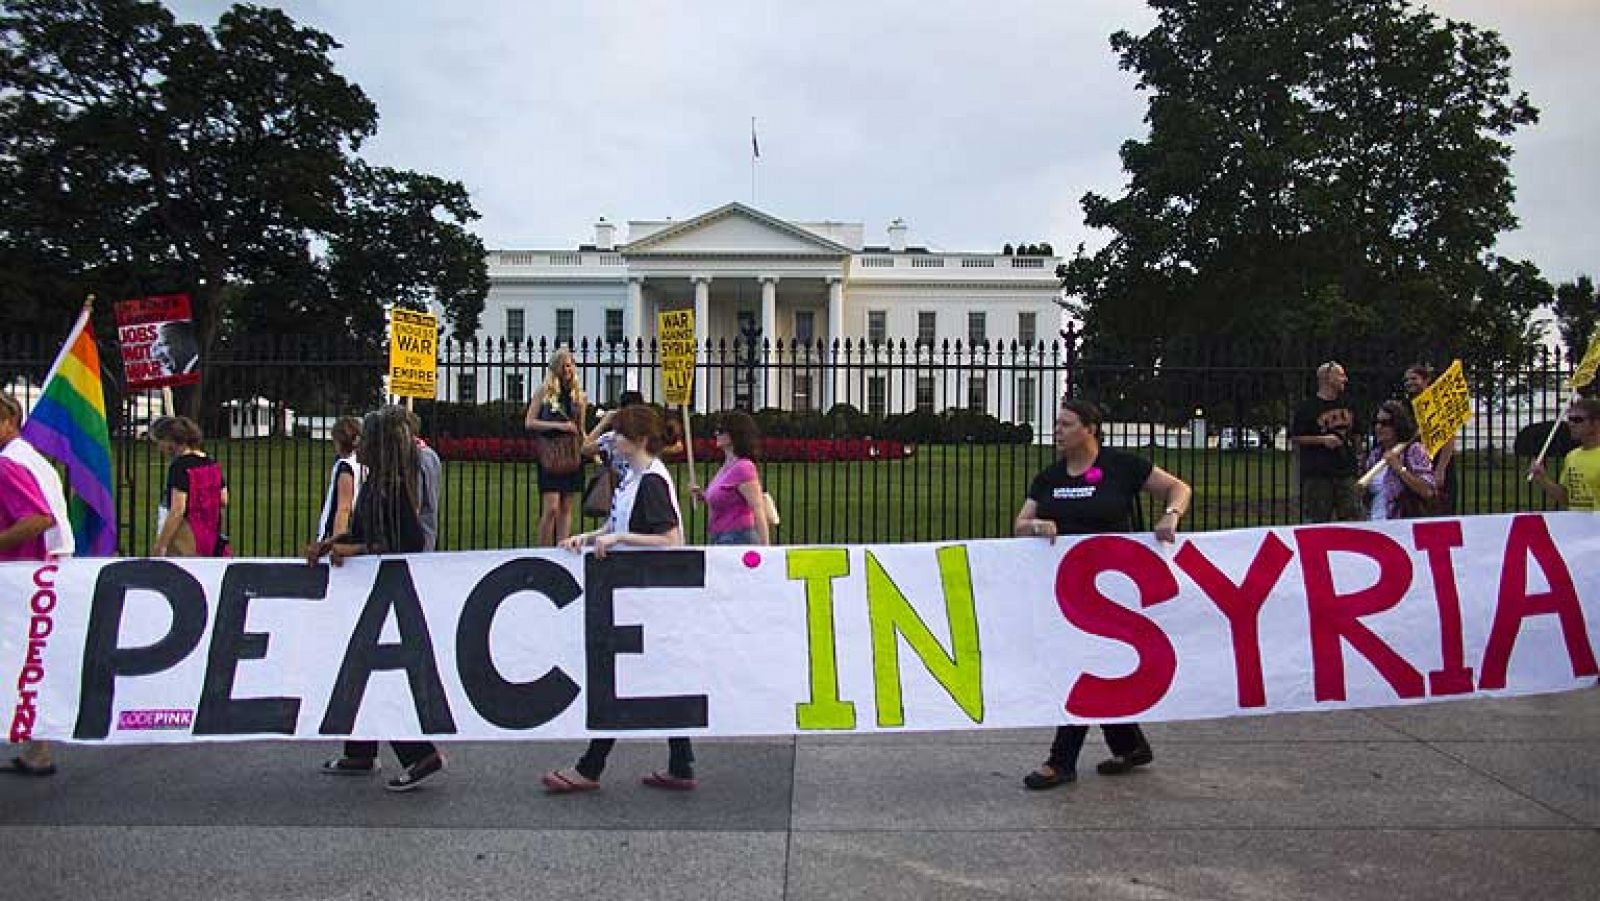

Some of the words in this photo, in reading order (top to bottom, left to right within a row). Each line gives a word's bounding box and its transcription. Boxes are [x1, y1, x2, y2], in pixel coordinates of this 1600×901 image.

[662, 312, 689, 329] WAR
[119, 324, 159, 343] JOBS
[122, 345, 153, 362] NOT
[397, 336, 432, 355] WAR
[126, 361, 162, 381] WAR
[393, 367, 434, 382] EMPIRE
[74, 550, 708, 739] PEACE
[787, 544, 984, 730] IN
[1055, 514, 1600, 720] SYRIA
[120, 711, 192, 726] CODEPINK
